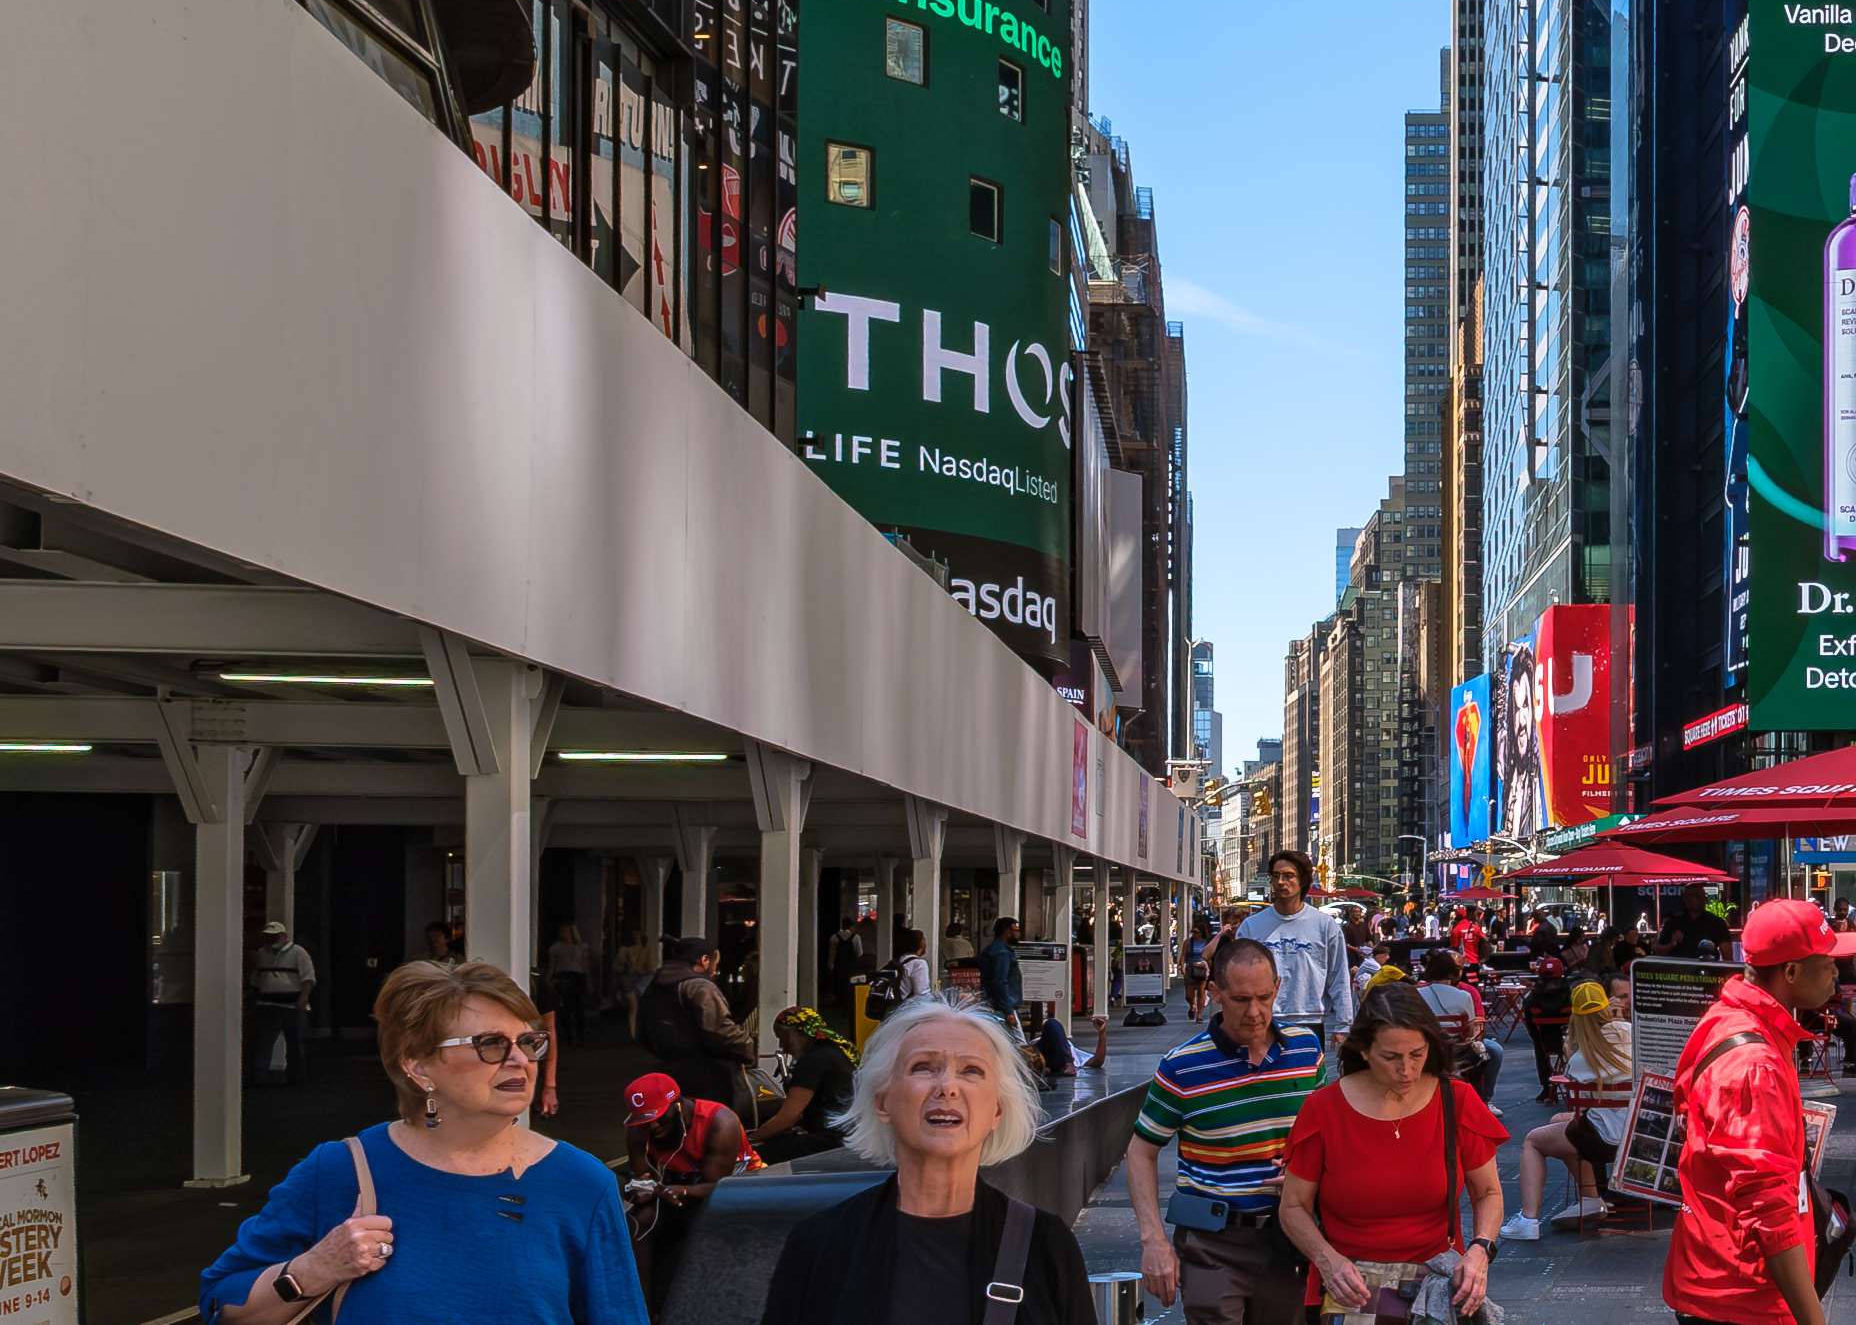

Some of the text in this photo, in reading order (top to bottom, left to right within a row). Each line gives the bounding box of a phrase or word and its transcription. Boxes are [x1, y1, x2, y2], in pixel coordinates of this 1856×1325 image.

[1784, 5, 1852, 24] Vanilla
[806, 430, 1058, 505] LIFE NasdaqListed
[1797, 582, 1854, 614] Dr.
[1056, 686, 1085, 701] SPAIN
[1699, 785, 1780, 797] TIMES
[1671, 813, 1741, 828] SQUARE
[631, 1092, 645, 1108] C
[22, 1141, 61, 1166] LOPEZ
[17, 1208, 63, 1225] MORMON
[25, 1287, 51, 1309] 9-14
